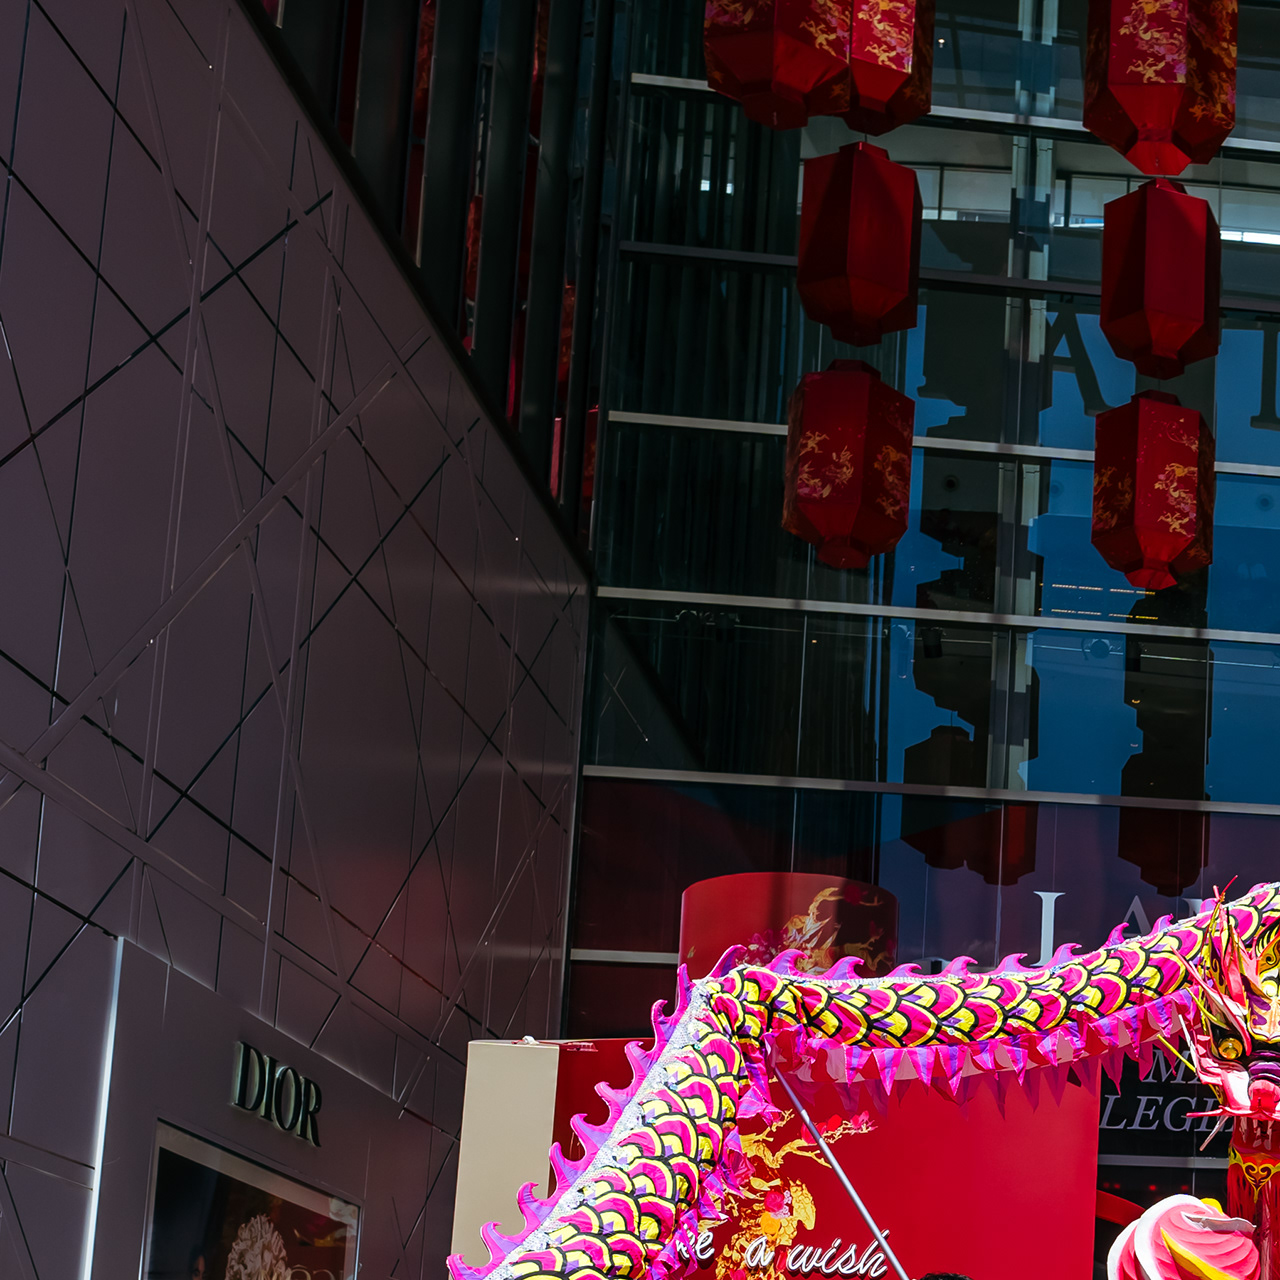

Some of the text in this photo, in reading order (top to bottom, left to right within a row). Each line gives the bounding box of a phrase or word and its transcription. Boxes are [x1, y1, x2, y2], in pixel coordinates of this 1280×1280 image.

[229, 1040, 322, 1148] DIOR
[745, 1235, 775, 1269] a
[786, 1229, 890, 1279] wish
